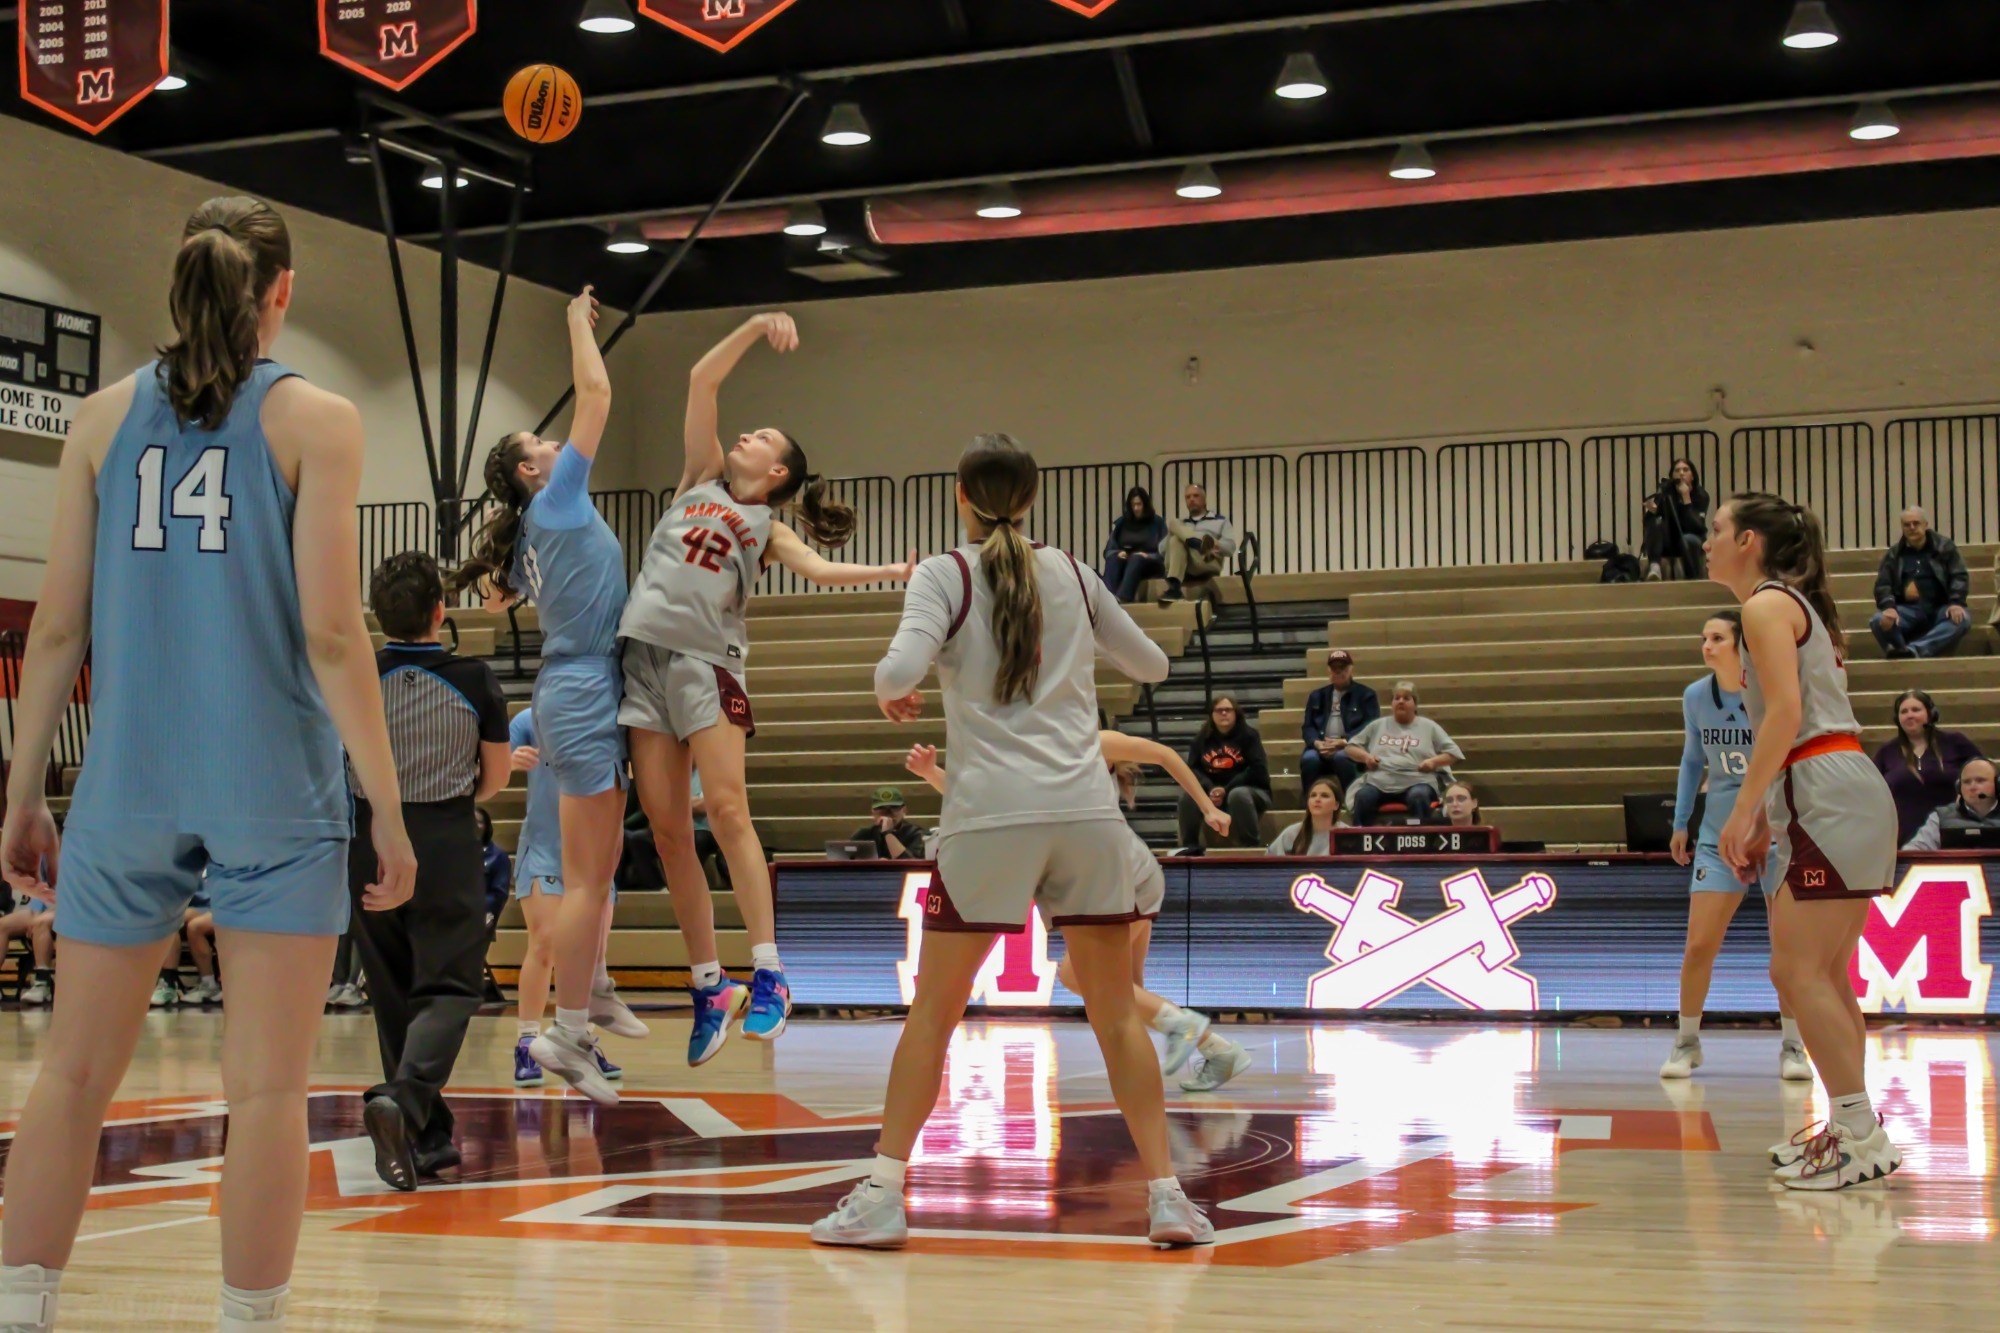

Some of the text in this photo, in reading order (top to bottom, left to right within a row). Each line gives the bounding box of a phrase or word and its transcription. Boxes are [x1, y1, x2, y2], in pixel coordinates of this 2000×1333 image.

[39, 5, 64, 17] 2003
[338, 8, 365, 20] 2005
[386, 1, 412, 13] 2020
[38, 21, 64, 33] 2004
[84, 15, 107, 27] 2014
[38, 37, 64, 49] 2005
[84, 31, 107, 43] 2019
[380, 21, 417, 60] M
[37, 53, 64, 65] 2006
[84, 47, 108, 60] 2020
[77, 68, 113, 104] M
[528, 80, 550, 130] Wilson
[56, 313, 92, 334] HOME
[41, 395, 62, 413] TO
[131, 444, 233, 553] 14
[683, 502, 758, 551] MARYVILLE
[681, 525, 732, 573] 42
[731, 698, 746, 715] M
[1703, 728, 1755, 745] BRUIN
[1719, 751, 1749, 775] 13
[1804, 869, 1825, 887] M
[927, 894, 941, 914] M
[1846, 864, 1993, 1013] M
